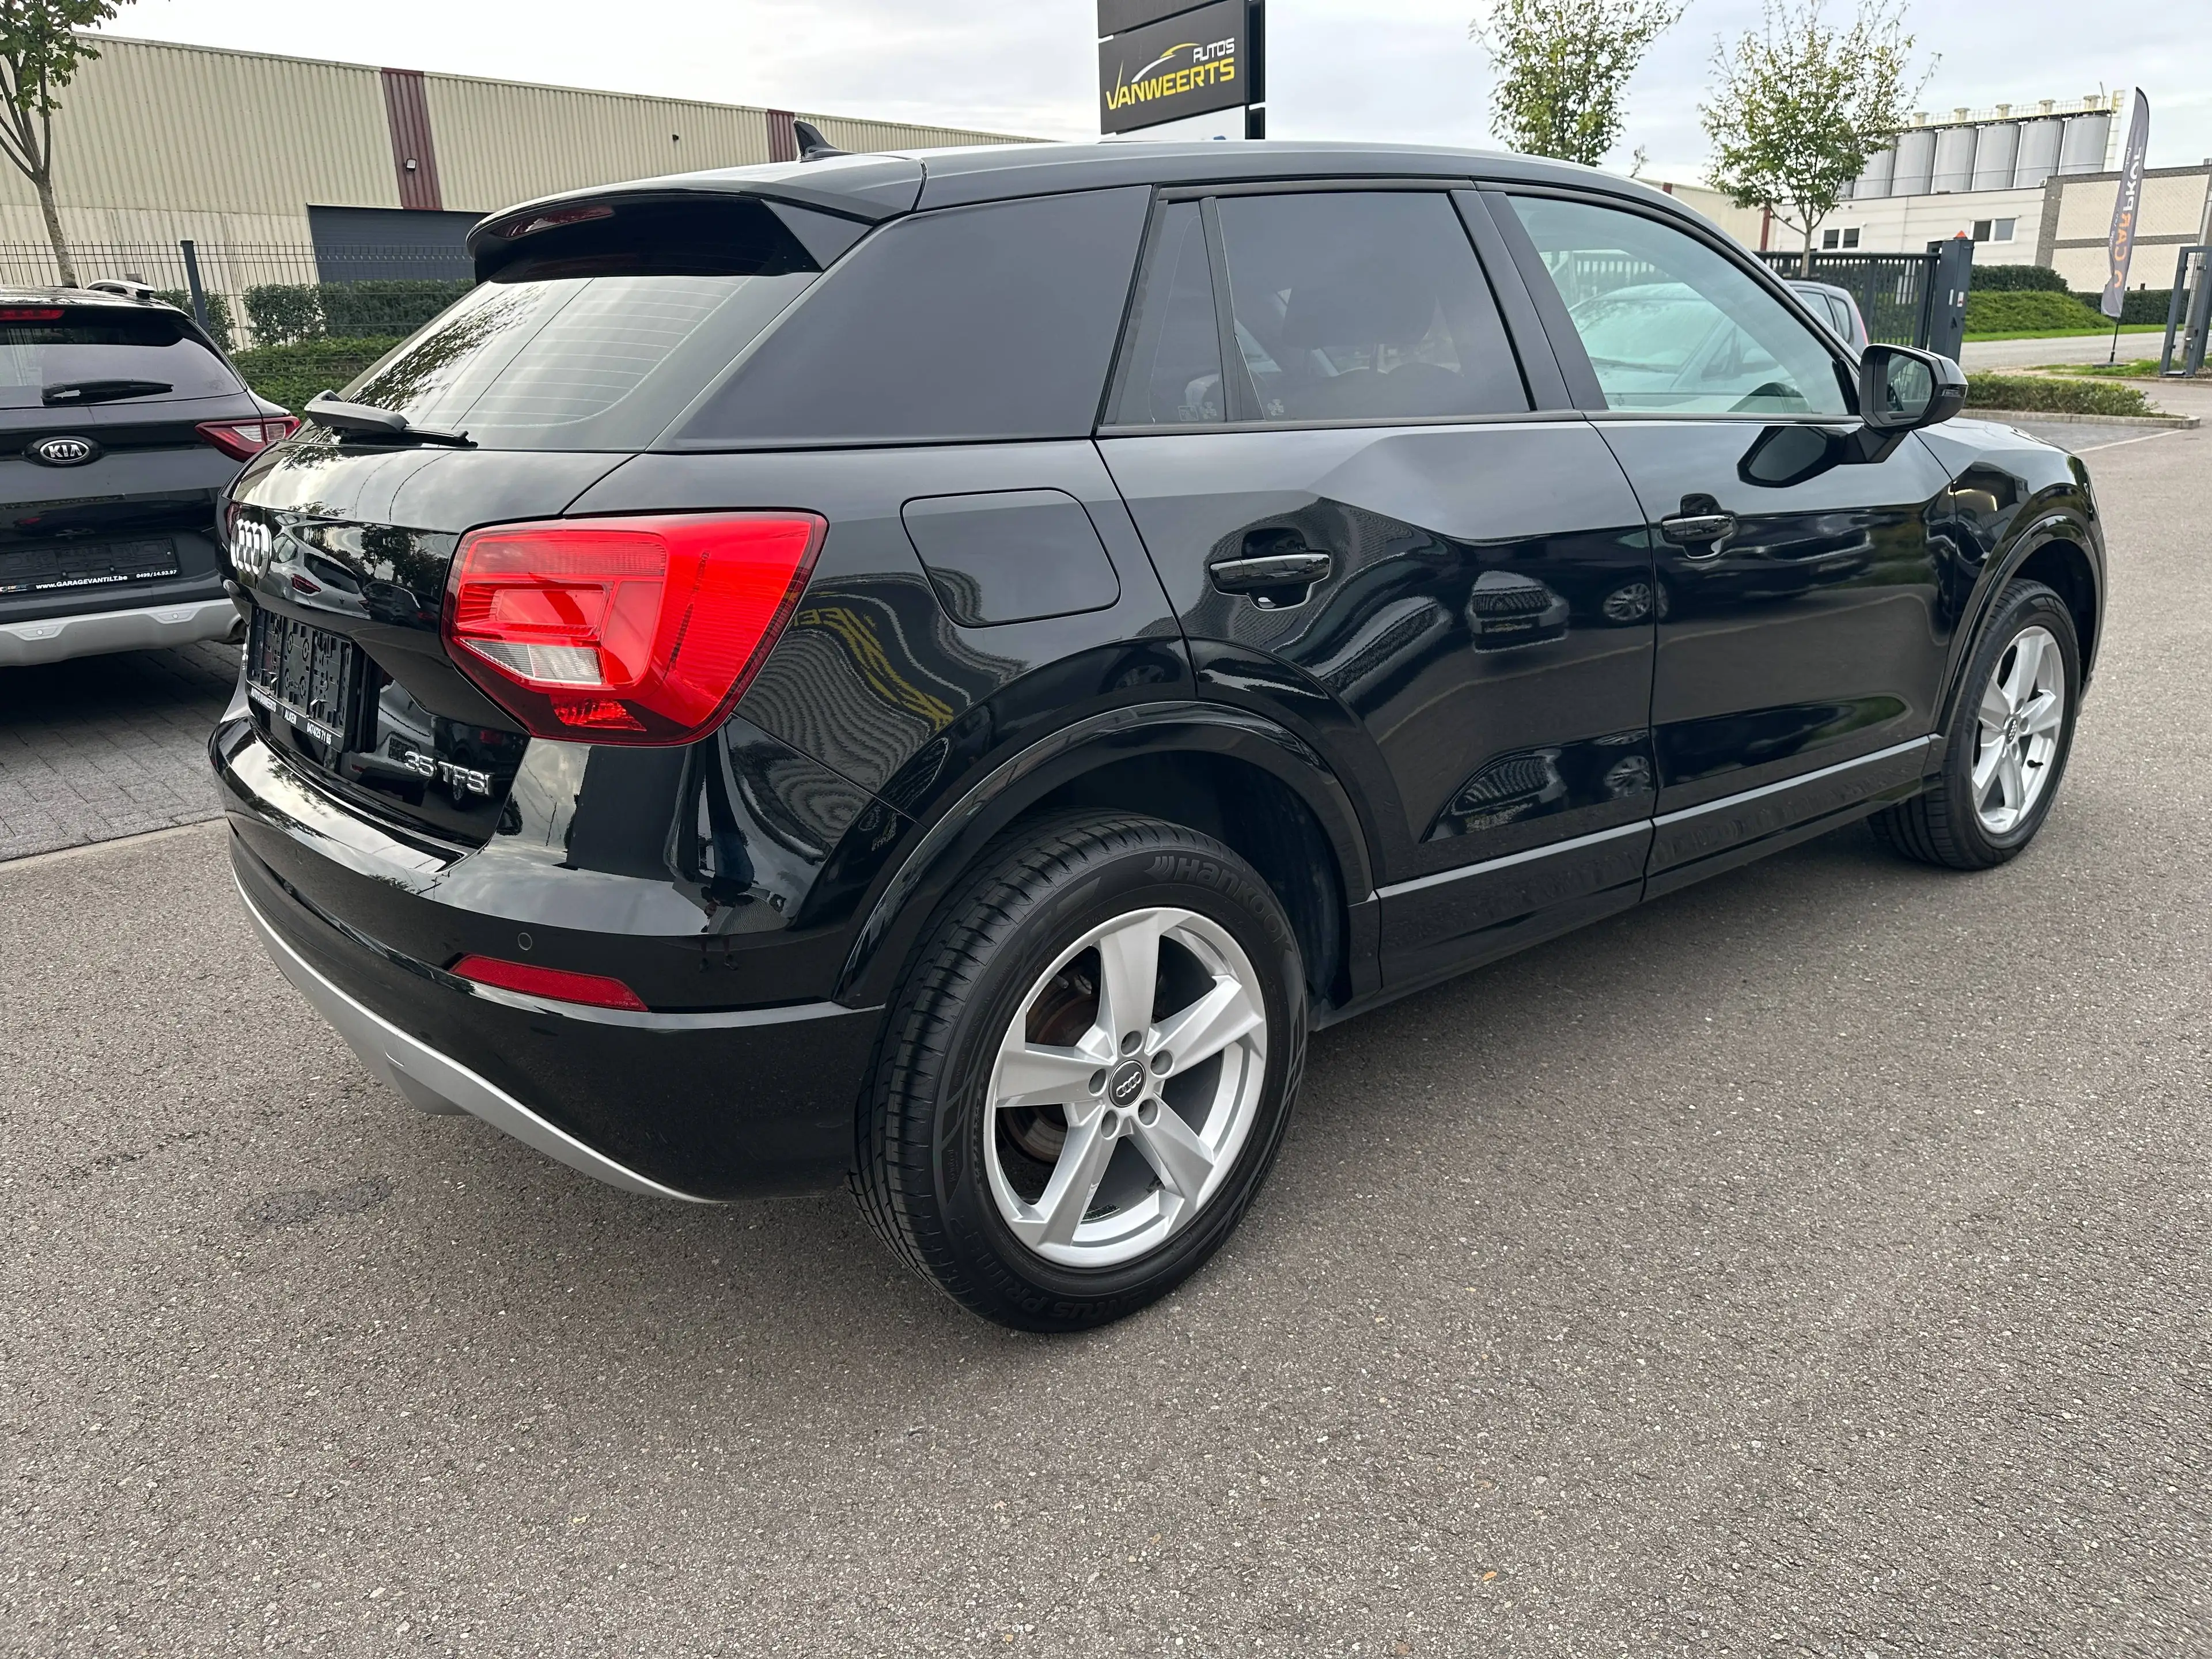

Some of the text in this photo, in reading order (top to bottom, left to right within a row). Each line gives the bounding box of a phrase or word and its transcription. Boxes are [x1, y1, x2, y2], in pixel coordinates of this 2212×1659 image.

[1193, 37, 1235, 63] AUTOS
[1105, 57, 1235, 110] VANWEERTS
[48, 445, 82, 457] KIA
[36, 575, 128, 589] www.GARAGEVANTILT.be
[284, 709, 297, 725] ALKEN
[404, 751, 491, 795] 35 TFSI
